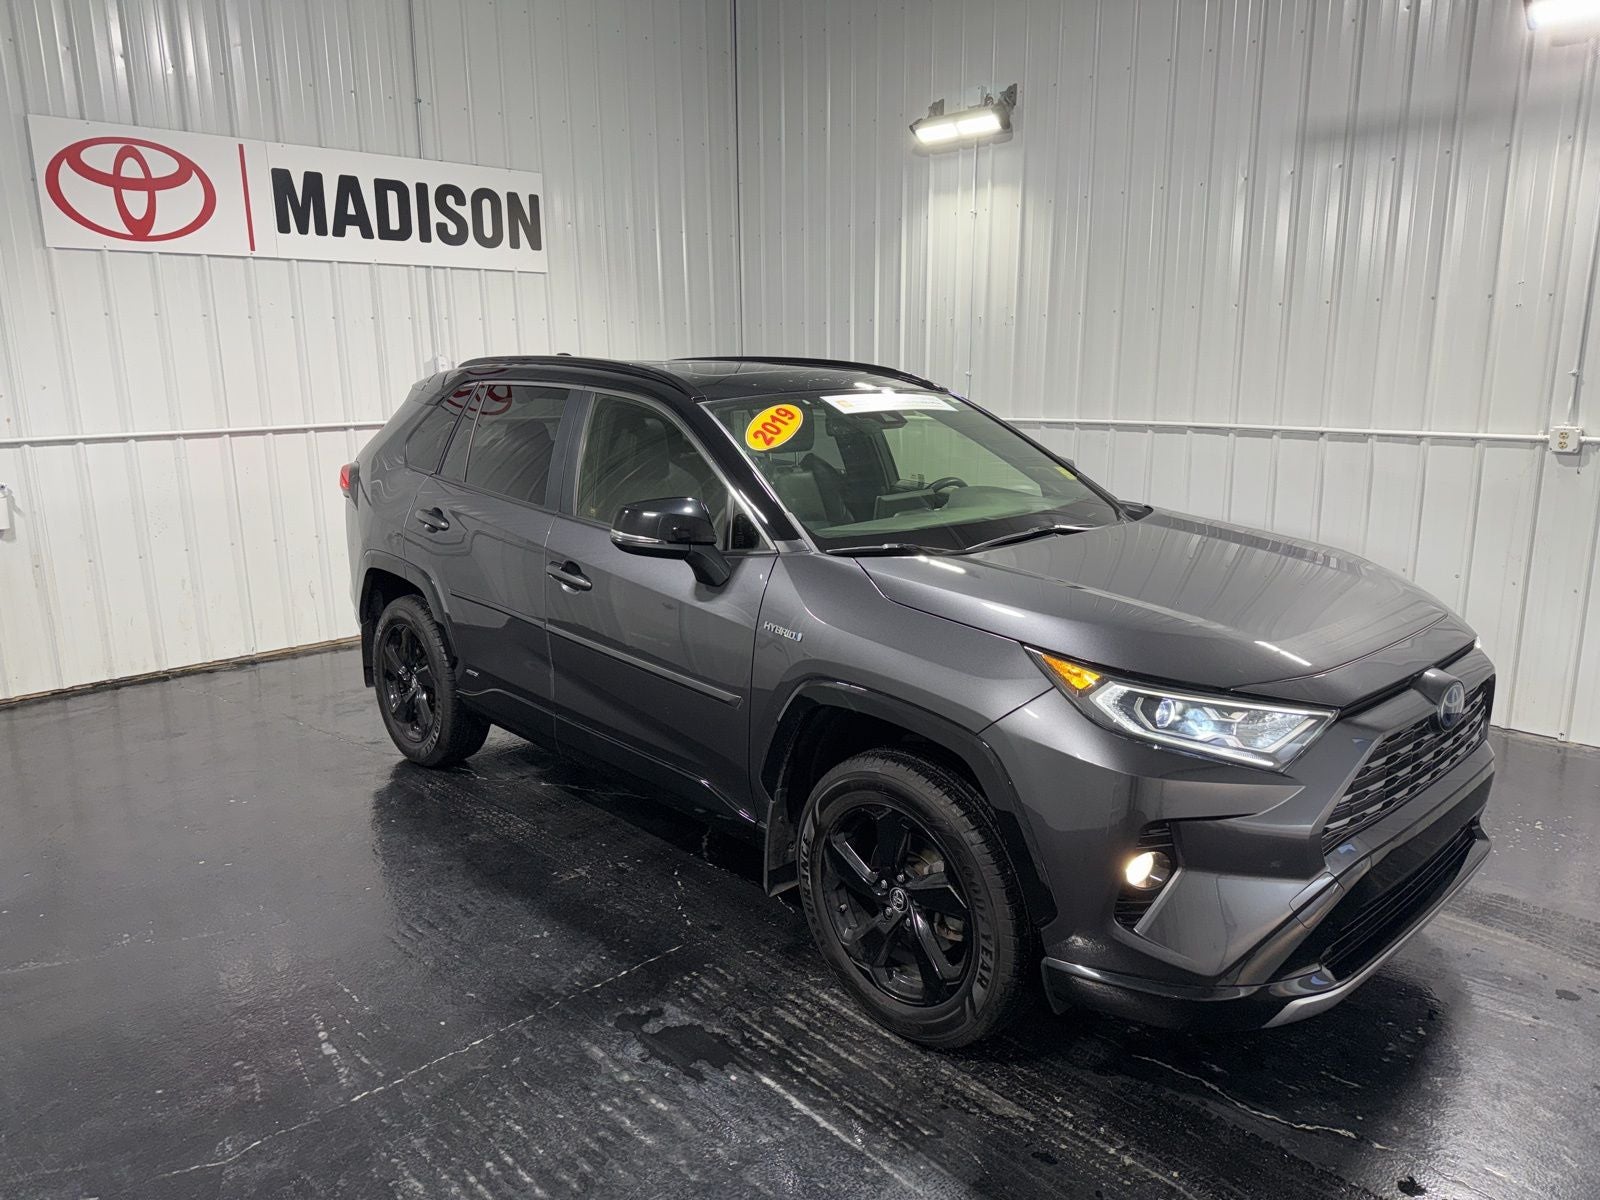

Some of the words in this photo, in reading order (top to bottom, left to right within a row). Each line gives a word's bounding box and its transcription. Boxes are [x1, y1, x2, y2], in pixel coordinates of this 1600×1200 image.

[271, 167, 542, 251] MADISON
[753, 408, 795, 446] 2019
[763, 621, 797, 640] HYBRID
